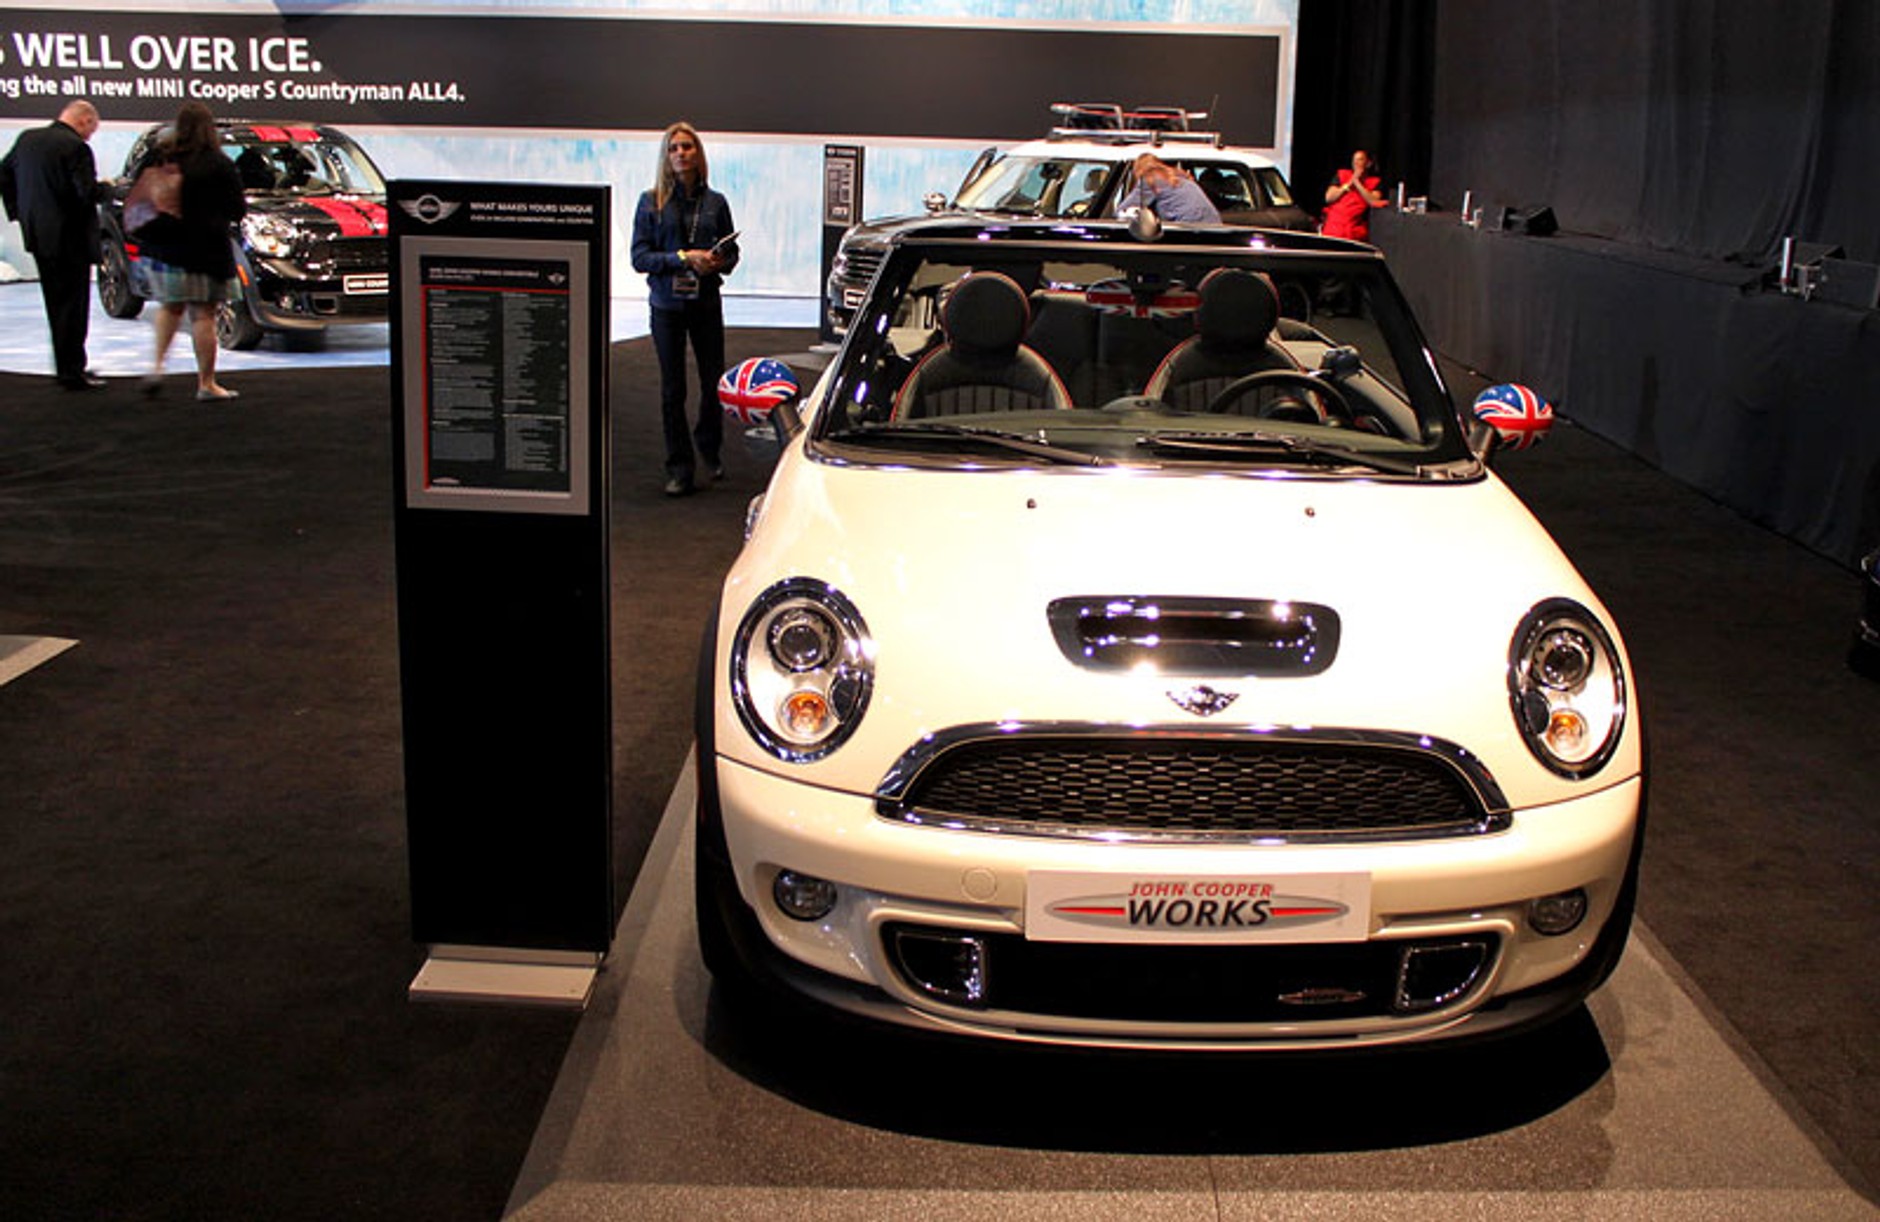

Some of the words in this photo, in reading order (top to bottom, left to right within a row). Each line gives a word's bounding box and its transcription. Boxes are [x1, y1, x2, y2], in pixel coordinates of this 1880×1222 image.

[12, 32, 124, 69] WELL
[130, 35, 239, 72] OVER
[249, 37, 323, 73] ICE.
[23, 74, 58, 96] the
[61, 75, 87, 96] all
[90, 80, 133, 97] new
[137, 78, 184, 98] MINI
[189, 79, 260, 103] Cooper
[263, 80, 277, 99] S
[280, 80, 404, 105] Countryman
[408, 82, 466, 102] ALL4.
[470, 202, 495, 210] WHAT
[498, 203, 527, 212] MAKES
[1129, 882, 1189, 897] JOHN
[1193, 882, 1274, 897] COOPER
[1128, 899, 1271, 927] WORKS
